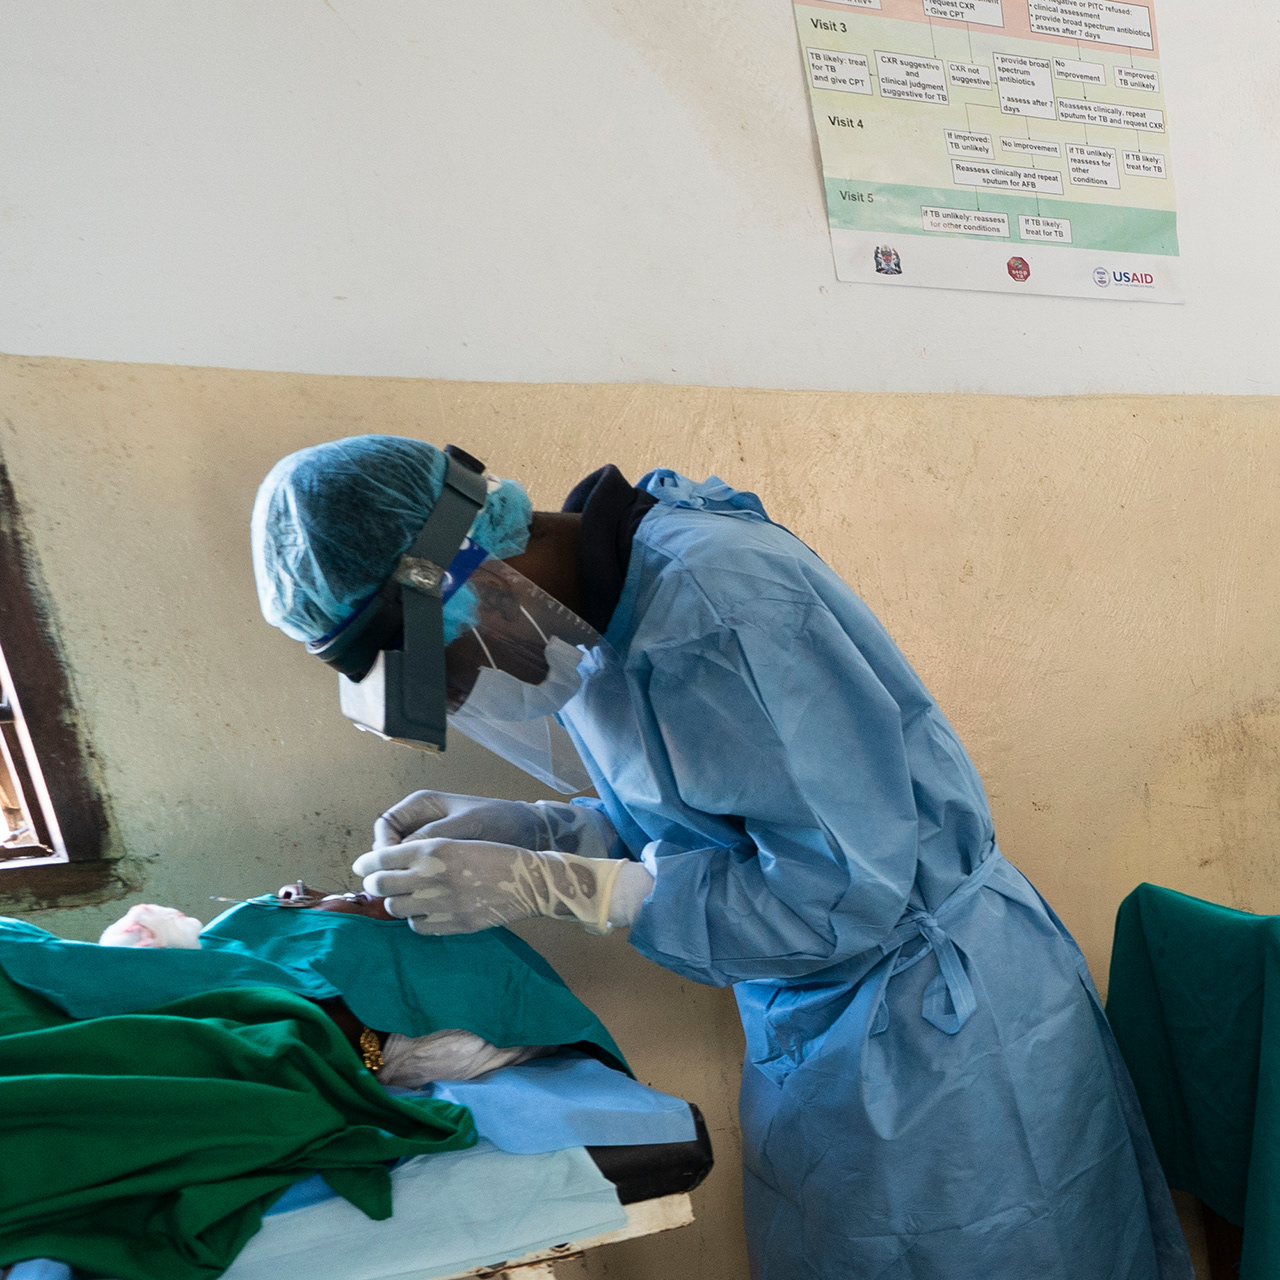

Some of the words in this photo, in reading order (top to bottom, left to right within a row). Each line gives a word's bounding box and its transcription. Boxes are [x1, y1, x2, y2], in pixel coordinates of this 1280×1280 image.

[959, 1, 975, 10] CXR
[1088, 3, 1103, 11] PITC
[1105, 6, 1131, 15] refused:
[931, 7, 947, 15] Give
[950, 10, 965, 19] CPT
[1034, 5, 1058, 13] clinical
[1060, 9, 1100, 20] assessment
[810, 18, 837, 32] Visit
[840, 22, 847, 33] 3
[1035, 14, 1060, 24] provide
[1063, 17, 1082, 27] broad
[1084, 22, 1115, 32] spectrum
[1117, 27, 1150, 38] antibiotics
[1036, 24, 1060, 33] assess
[1062, 28, 1077, 36] after
[1085, 31, 1100, 40] days
[810, 52, 821, 61] TB
[823, 54, 847, 64] likely:
[849, 58, 866, 67] treat
[881, 55, 898, 64] CXR
[900, 59, 940, 71] suggestive
[1001, 57, 1028, 67] provide
[1029, 59, 1050, 69] broad
[812, 63, 823, 71] for
[826, 64, 836, 73] TB
[905, 70, 919, 78] and
[950, 63, 965, 72] CXR
[968, 67, 980, 75] not
[998, 66, 1030, 76] spectrum
[814, 74, 829, 82] and
[831, 76, 847, 86] give
[849, 78, 865, 87] CPT
[952, 75, 990, 86] suggestive
[999, 76, 1035, 87] antibiotics
[1057, 71, 1100, 82] improvement
[1124, 70, 1156, 81] improved:
[881, 77, 908, 87] clinical
[910, 81, 944, 92] judgment
[1120, 78, 1128, 86] TB
[1131, 80, 1155, 90] unlikely
[883, 88, 923, 99] suggestive
[925, 91, 935, 99] for
[937, 93, 947, 102] TB
[1007, 97, 1030, 105] assess
[1032, 99, 1048, 107] after
[1003, 105, 1020, 113] days
[1059, 101, 1092, 111] Reassess
[1125, 110, 1146, 119] repeat
[828, 115, 854, 128] Visit
[857, 119, 864, 129] 4
[1060, 111, 1086, 121] sputum
[1099, 115, 1107, 123] TB
[1123, 119, 1148, 129] request
[1149, 122, 1164, 130] CXR
[954, 133, 990, 143] improved:
[962, 143, 989, 154] unlikely
[1002, 140, 1012, 148] No
[1014, 142, 1058, 153] improvement
[1087, 150, 1114, 159] unlikely:
[1142, 155, 1161, 164] likely:
[1071, 158, 1100, 166] reassess
[1126, 163, 1141, 171] treat
[956, 164, 990, 174] Reassess
[991, 168, 1021, 179] clinically
[1037, 174, 1058, 182] repeat
[982, 177, 1008, 186] sputum
[1022, 181, 1036, 189] AFB
[1073, 176, 1108, 186] conditions
[839, 190, 865, 203] Visit
[867, 193, 874, 203] 5
[929, 210, 940, 218] TB
[942, 213, 972, 223] unlikely:
[974, 216, 1005, 224] reassess
[930, 220, 941, 228] for
[963, 224, 1001, 233] conditions
[1042, 220, 1062, 229] likely:
[1025, 228, 1041, 236] treat
[1113, 271, 1153, 284] USAID
